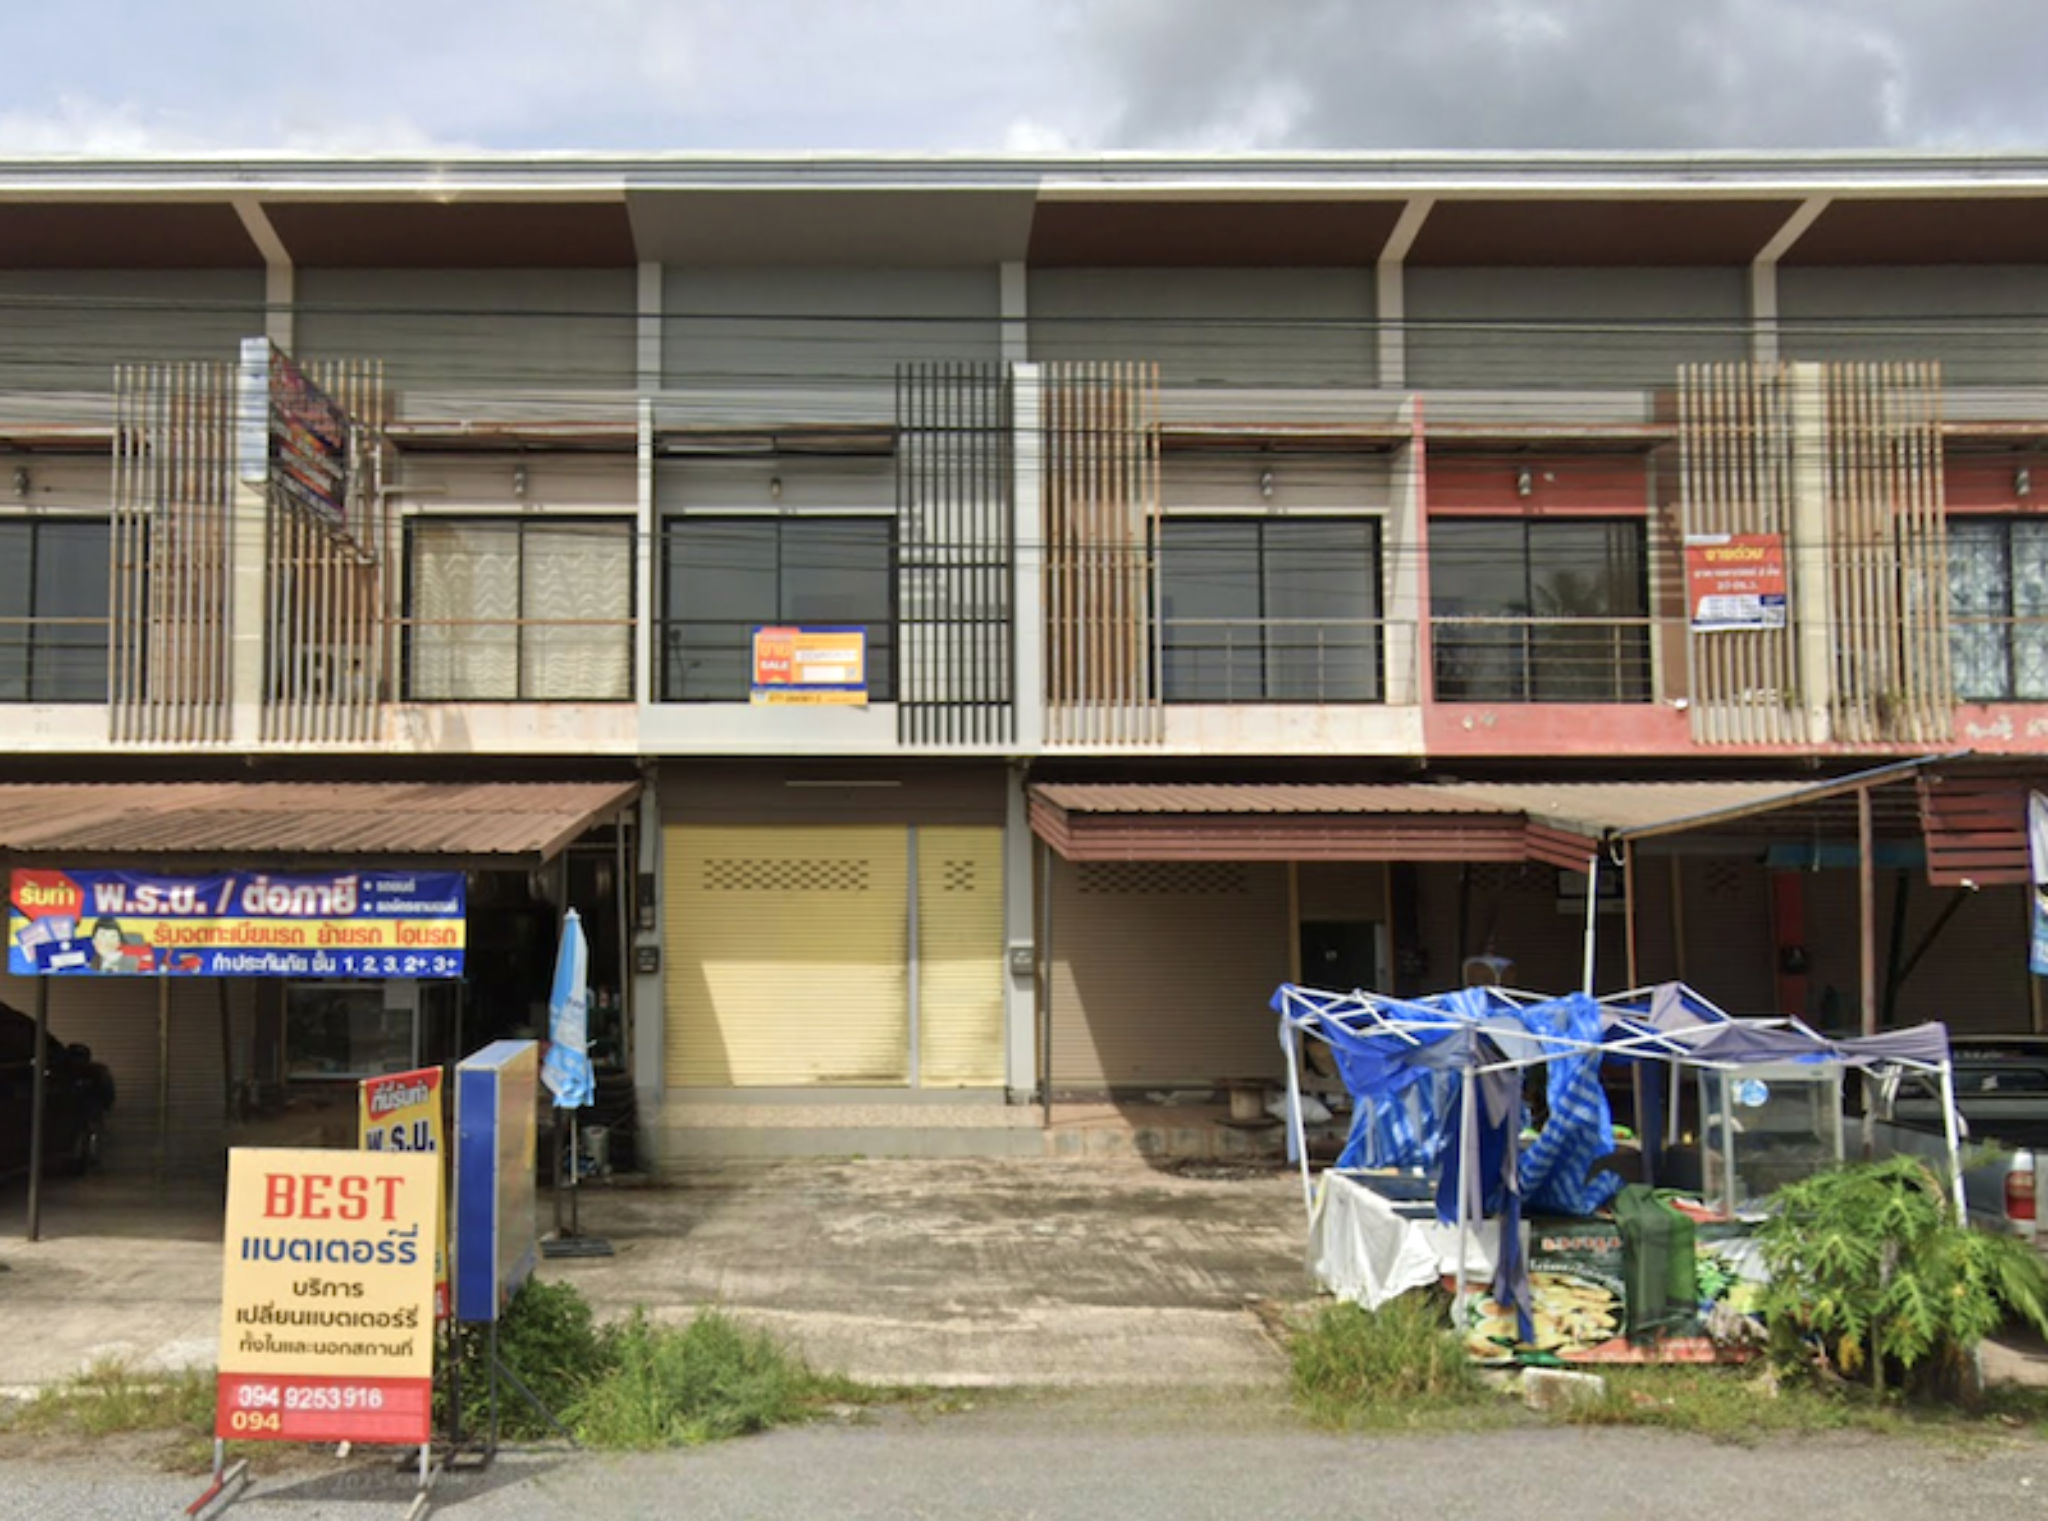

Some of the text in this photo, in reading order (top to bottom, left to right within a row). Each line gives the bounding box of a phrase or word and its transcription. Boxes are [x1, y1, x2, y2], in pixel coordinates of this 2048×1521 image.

[760, 659, 790, 671] SALE
[19, 880, 76, 906] รับทำ
[94, 882, 207, 914] พ.ร.บ.
[242, 875, 358, 916] ต่อภาษี
[154, 919, 457, 946] รับจดทะเบียนรถ ย้ายรถ โอนรถ
[212, 951, 308, 972] ทำประกันภัย
[312, 950, 336, 972] ชั้น
[370, 1077, 429, 1112] ที่นี่รับทำ
[366, 1121, 435, 1151] พร.บ.
[263, 1172, 405, 1221] BEST
[241, 1223, 419, 1265] แบตเตอร์รี่
[292, 1277, 365, 1298] บริการ
[235, 1300, 419, 1329] เปลี่ยนแบตเตอร์รี่
[239, 1330, 414, 1357] ทั้งในและนอกสถานที่
[239, 1384, 281, 1408] 094
[231, 1411, 282, 1431] 094
